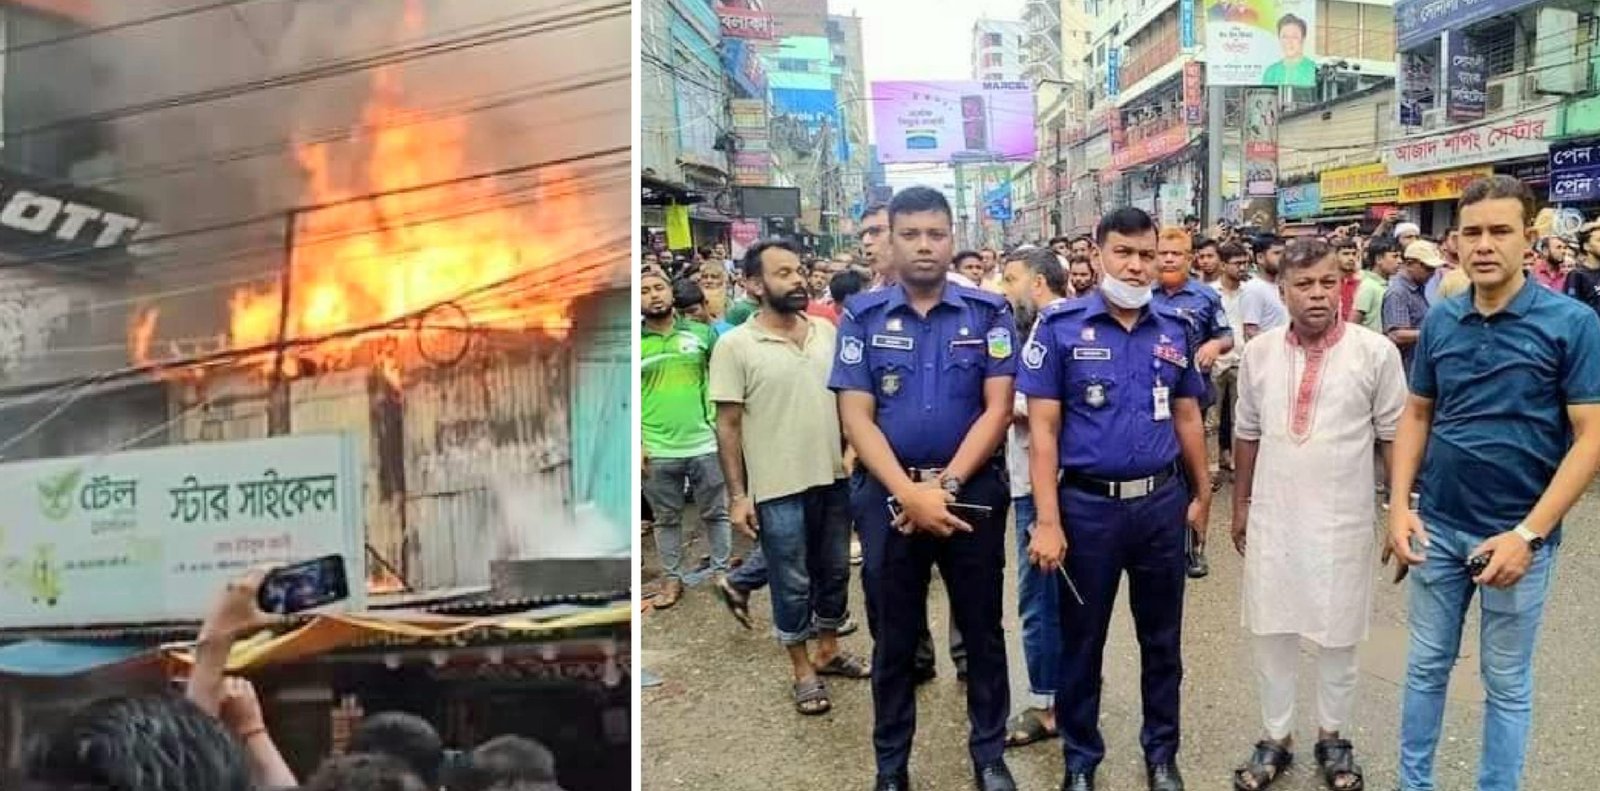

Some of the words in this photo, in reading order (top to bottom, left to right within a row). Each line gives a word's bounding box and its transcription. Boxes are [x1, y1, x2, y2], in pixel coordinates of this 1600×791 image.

[982, 80, 1030, 91] MARCEL
[1553, 147, 1593, 165] পেন
[1555, 178, 1593, 194] পেন
[0, 190, 163, 257] OTT
[168, 475, 231, 523] স্টার
[236, 468, 337, 520] সাইকেল
